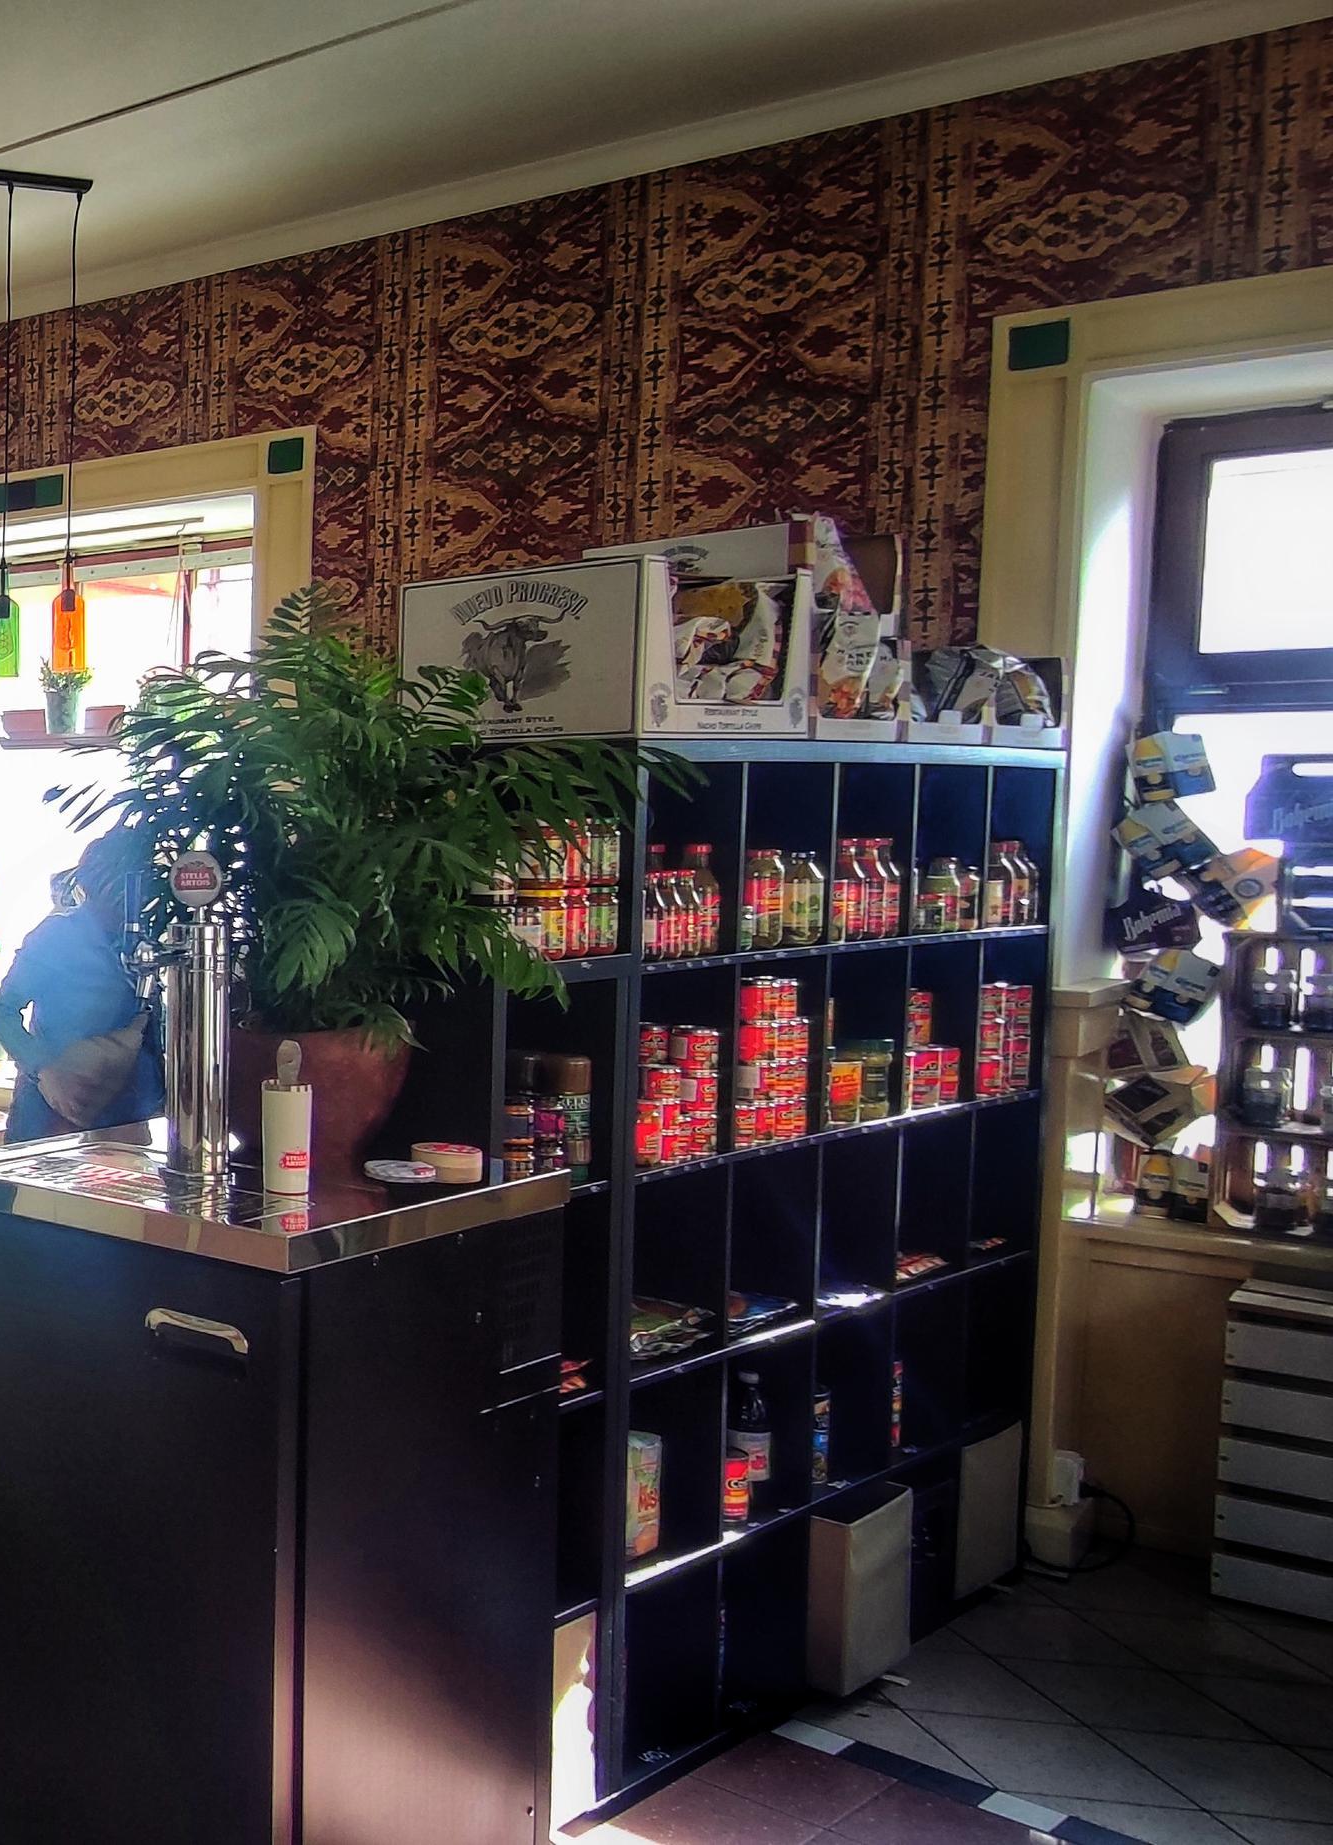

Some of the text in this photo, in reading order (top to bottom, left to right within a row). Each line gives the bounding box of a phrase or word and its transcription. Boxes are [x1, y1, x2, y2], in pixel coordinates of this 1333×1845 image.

[448, 579, 589, 626] NUEVO PROGRESO
[180, 872, 210, 880] STELLA
[1122, 903, 1182, 941] Bohemia
